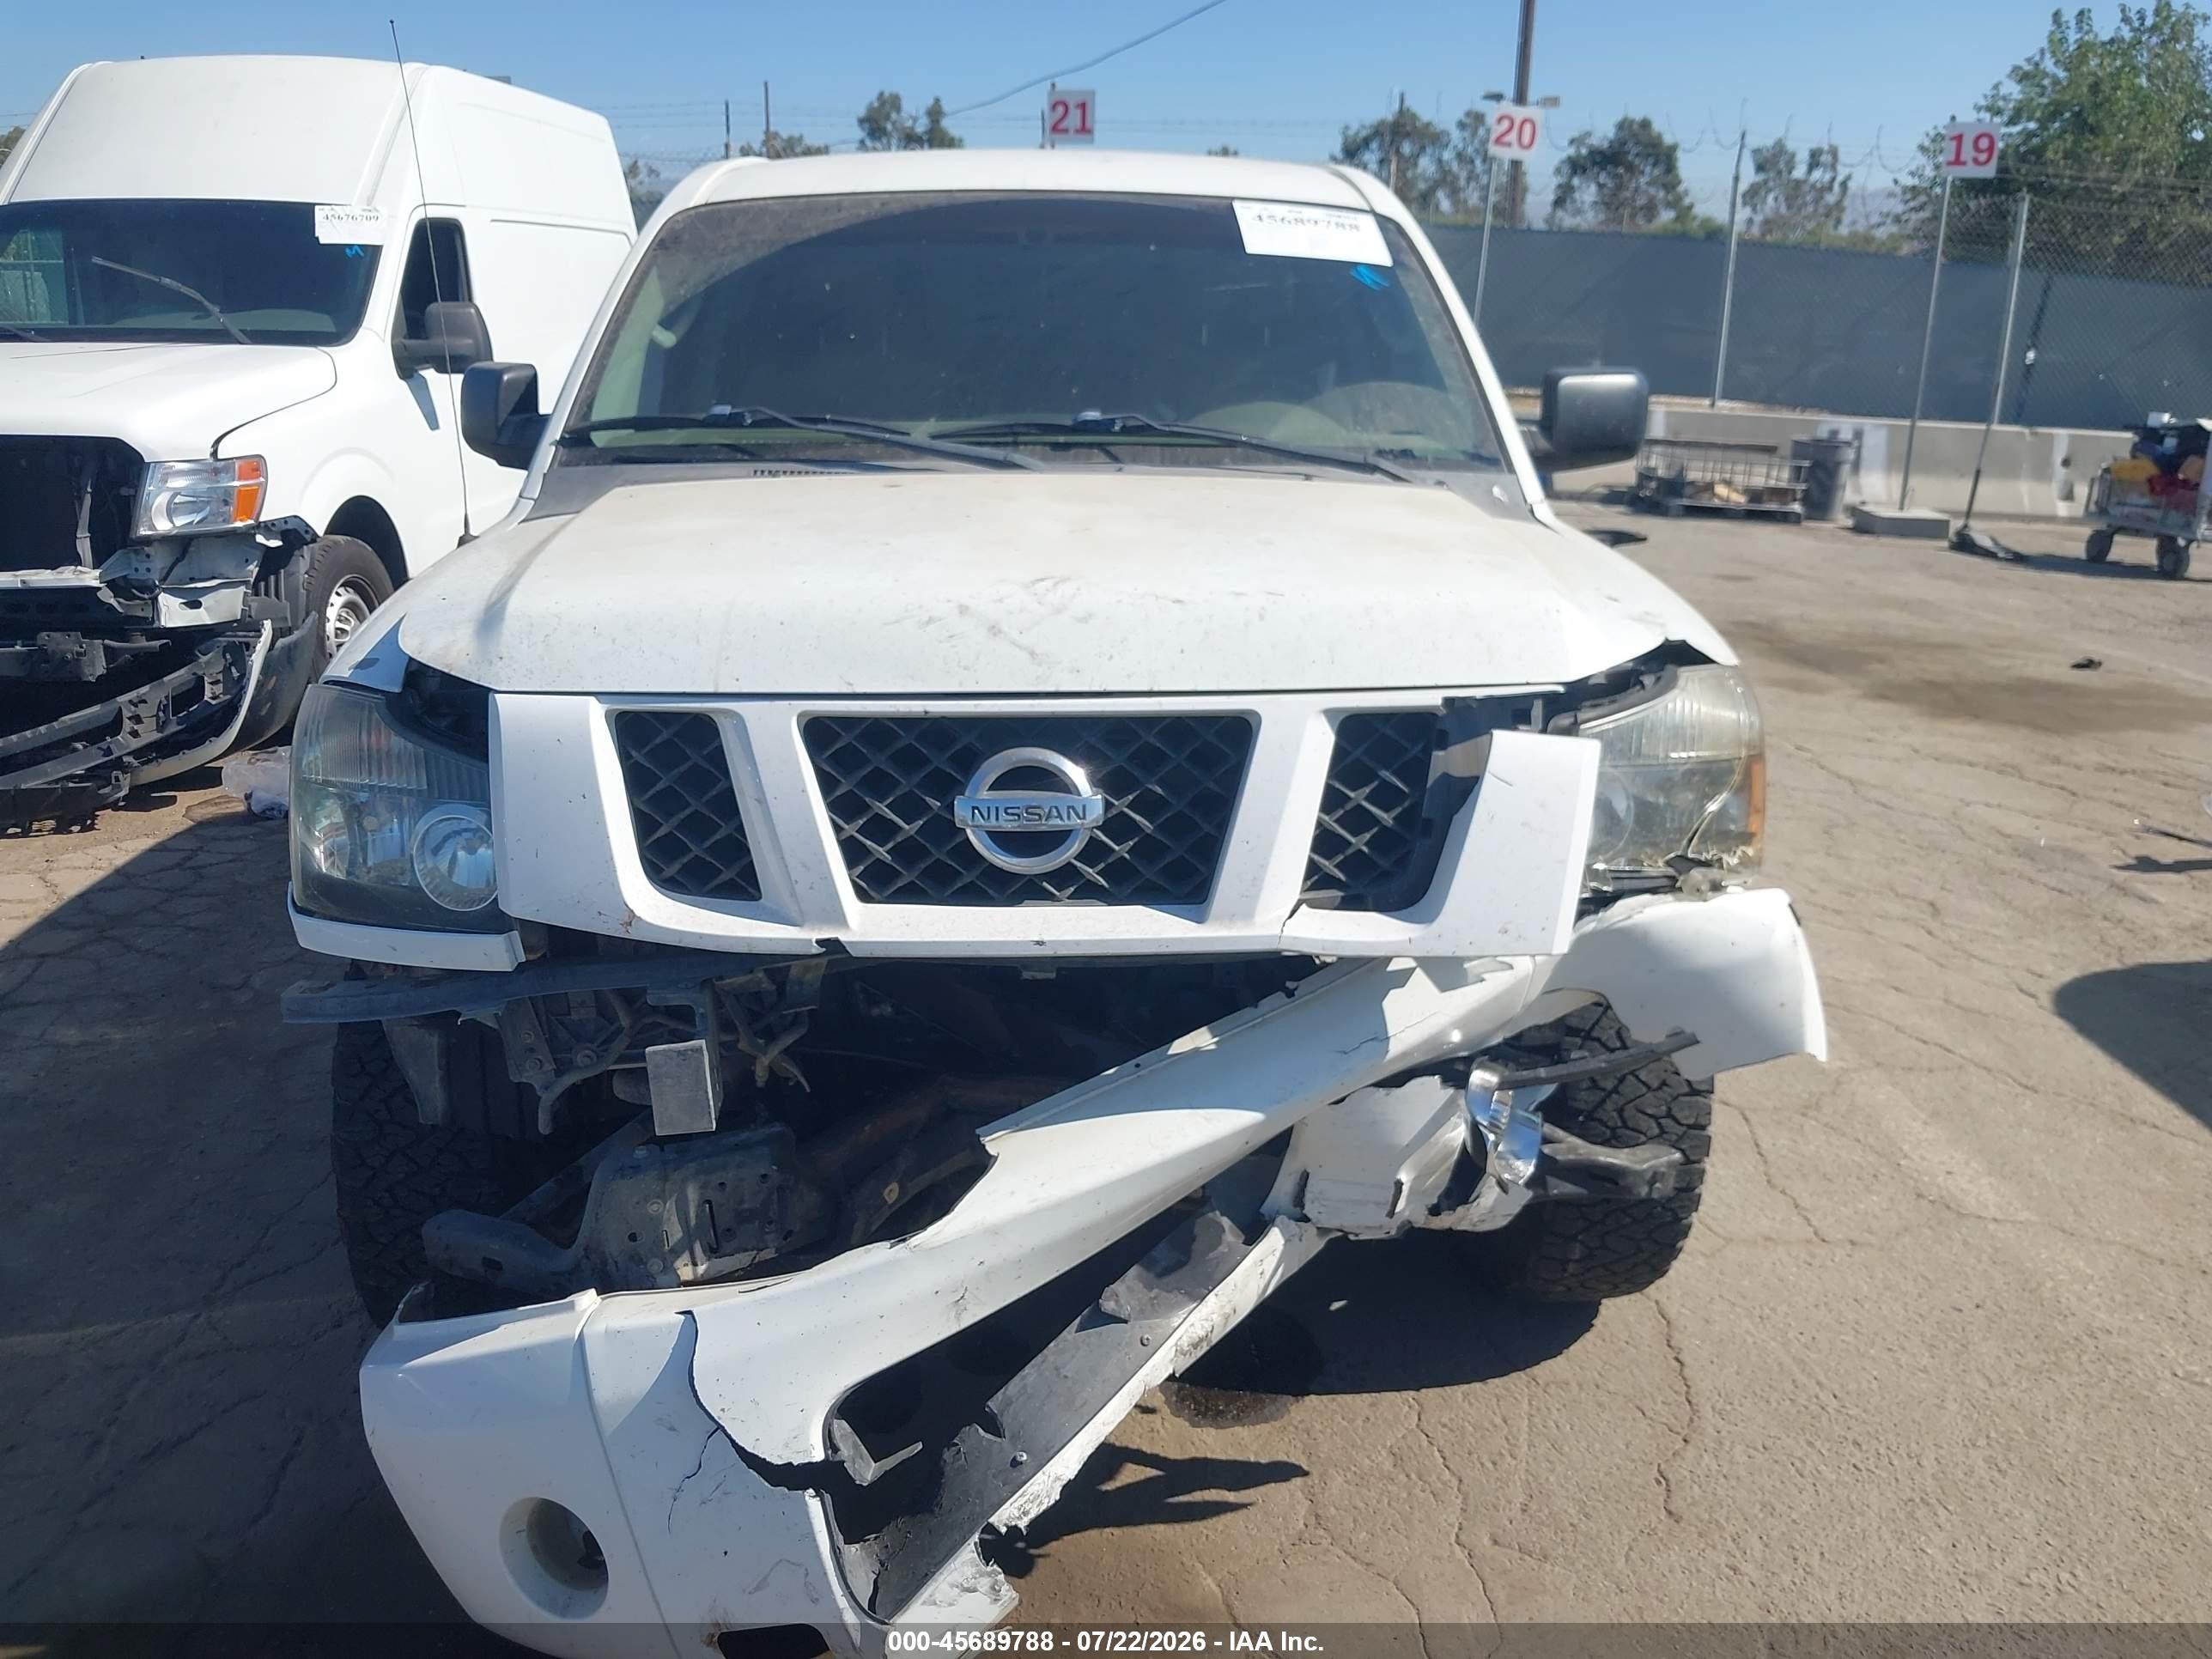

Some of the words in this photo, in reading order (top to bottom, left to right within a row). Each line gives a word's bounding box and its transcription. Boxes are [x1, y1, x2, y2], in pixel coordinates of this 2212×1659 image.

[1051, 100, 1091, 135] 21
[1494, 114, 1536, 149] 20
[1946, 132, 1996, 166] 19
[971, 805, 1087, 823] NISSAN
